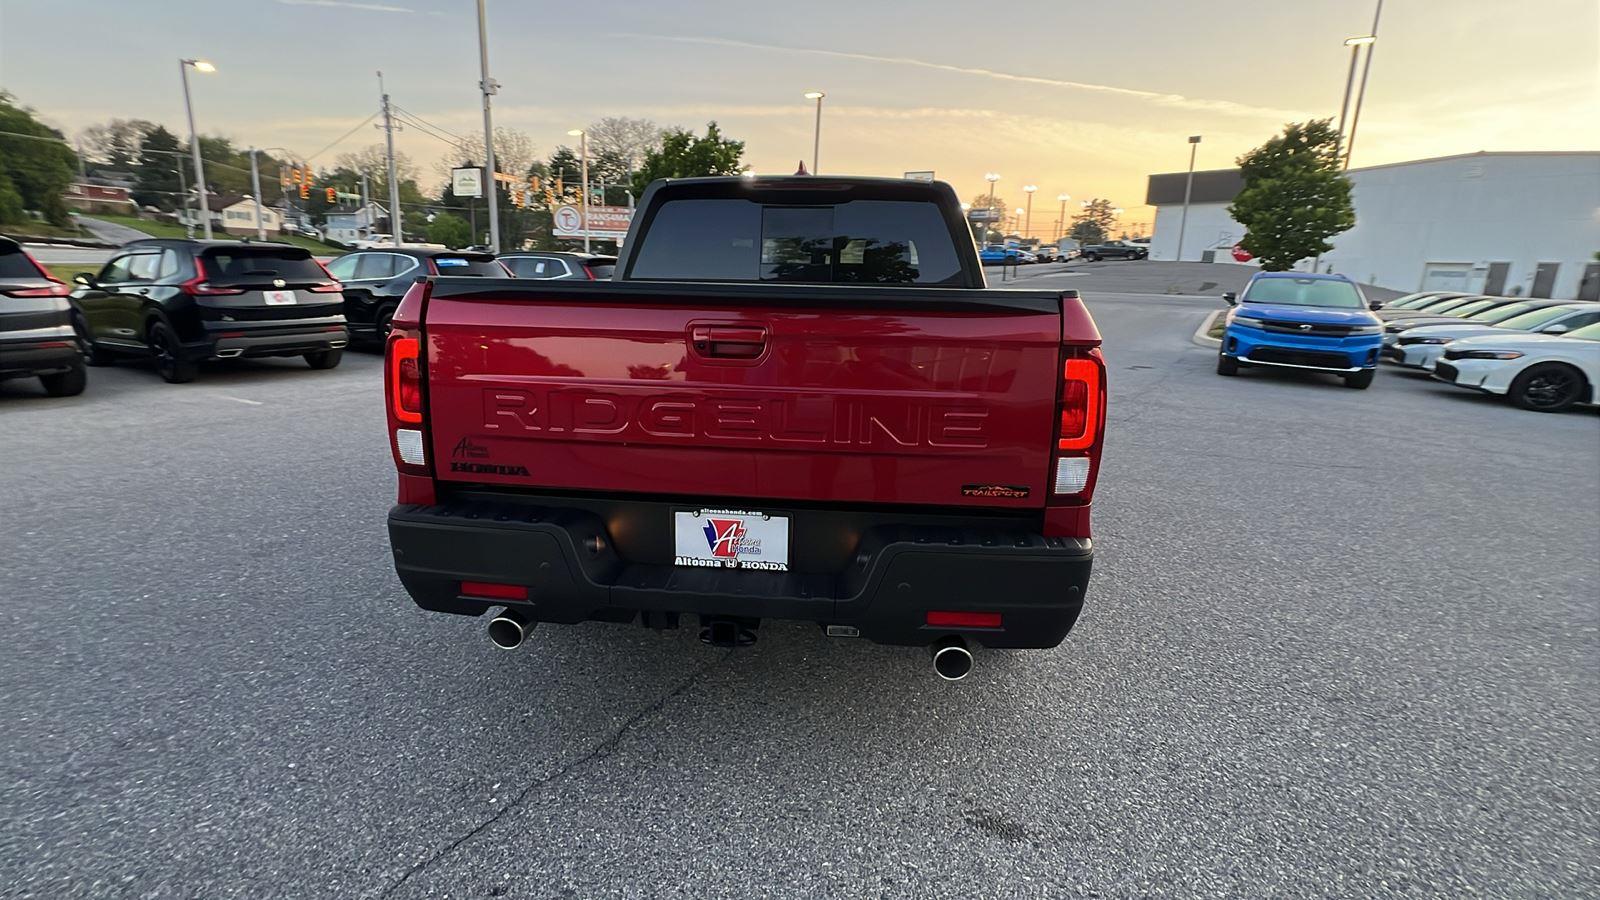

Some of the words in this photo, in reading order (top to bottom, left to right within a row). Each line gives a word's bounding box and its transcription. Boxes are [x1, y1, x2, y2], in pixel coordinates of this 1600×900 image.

[482, 387, 990, 450] RIDGELINE
[700, 508, 763, 516] altoonahonda.com
[674, 556, 722, 568] Altoona
[740, 561, 789, 571] HONDA
